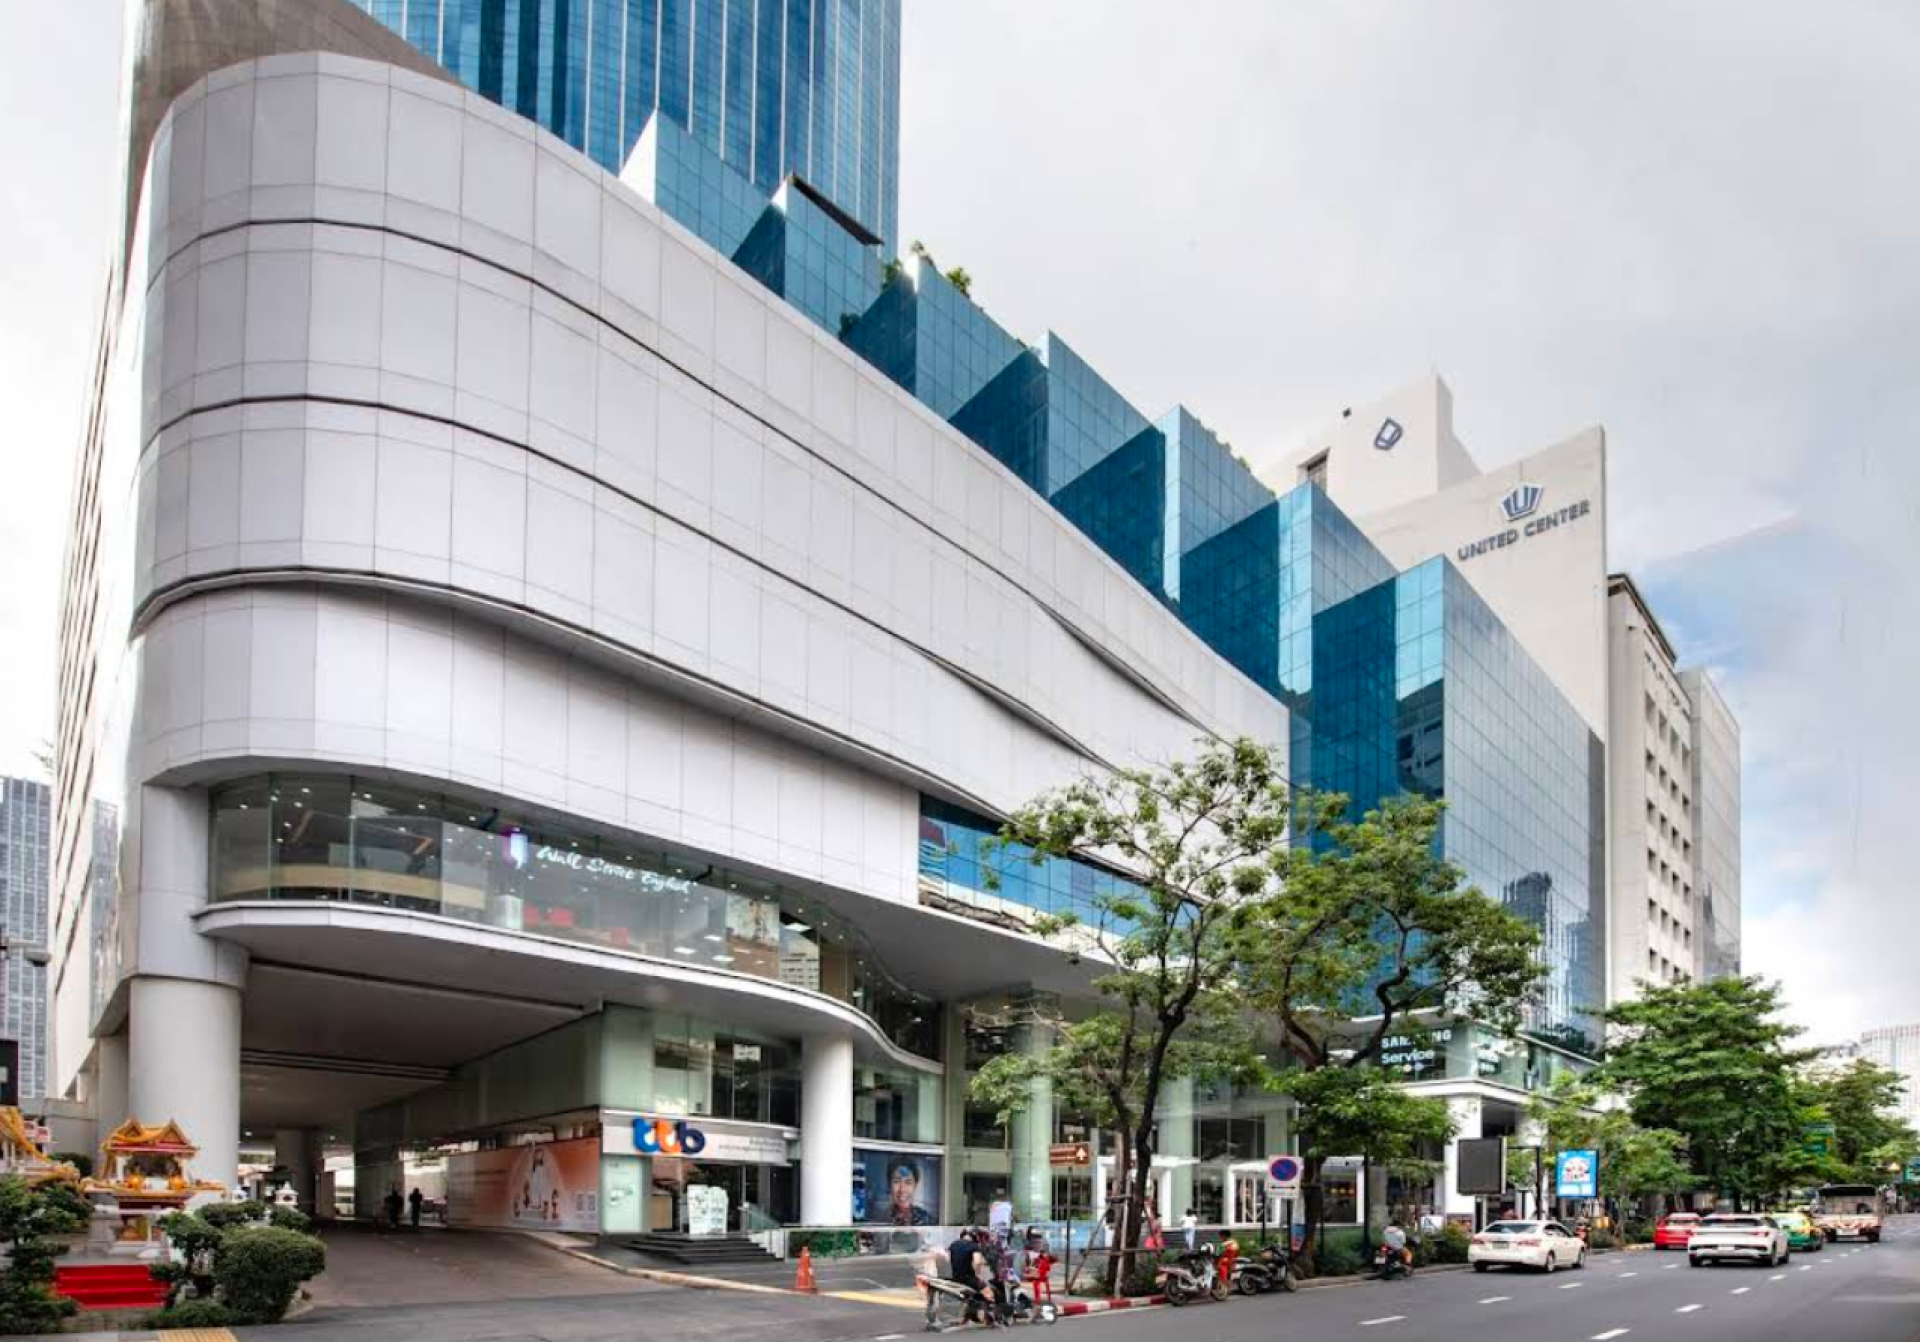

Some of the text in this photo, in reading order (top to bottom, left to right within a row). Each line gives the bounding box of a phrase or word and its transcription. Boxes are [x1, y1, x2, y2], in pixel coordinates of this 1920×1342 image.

[1458, 499, 1590, 561] UNITED CENTER
[537, 845, 583, 870] Wall
[1381, 1047, 1435, 1065] Service
[631, 1118, 706, 1154] ttb
